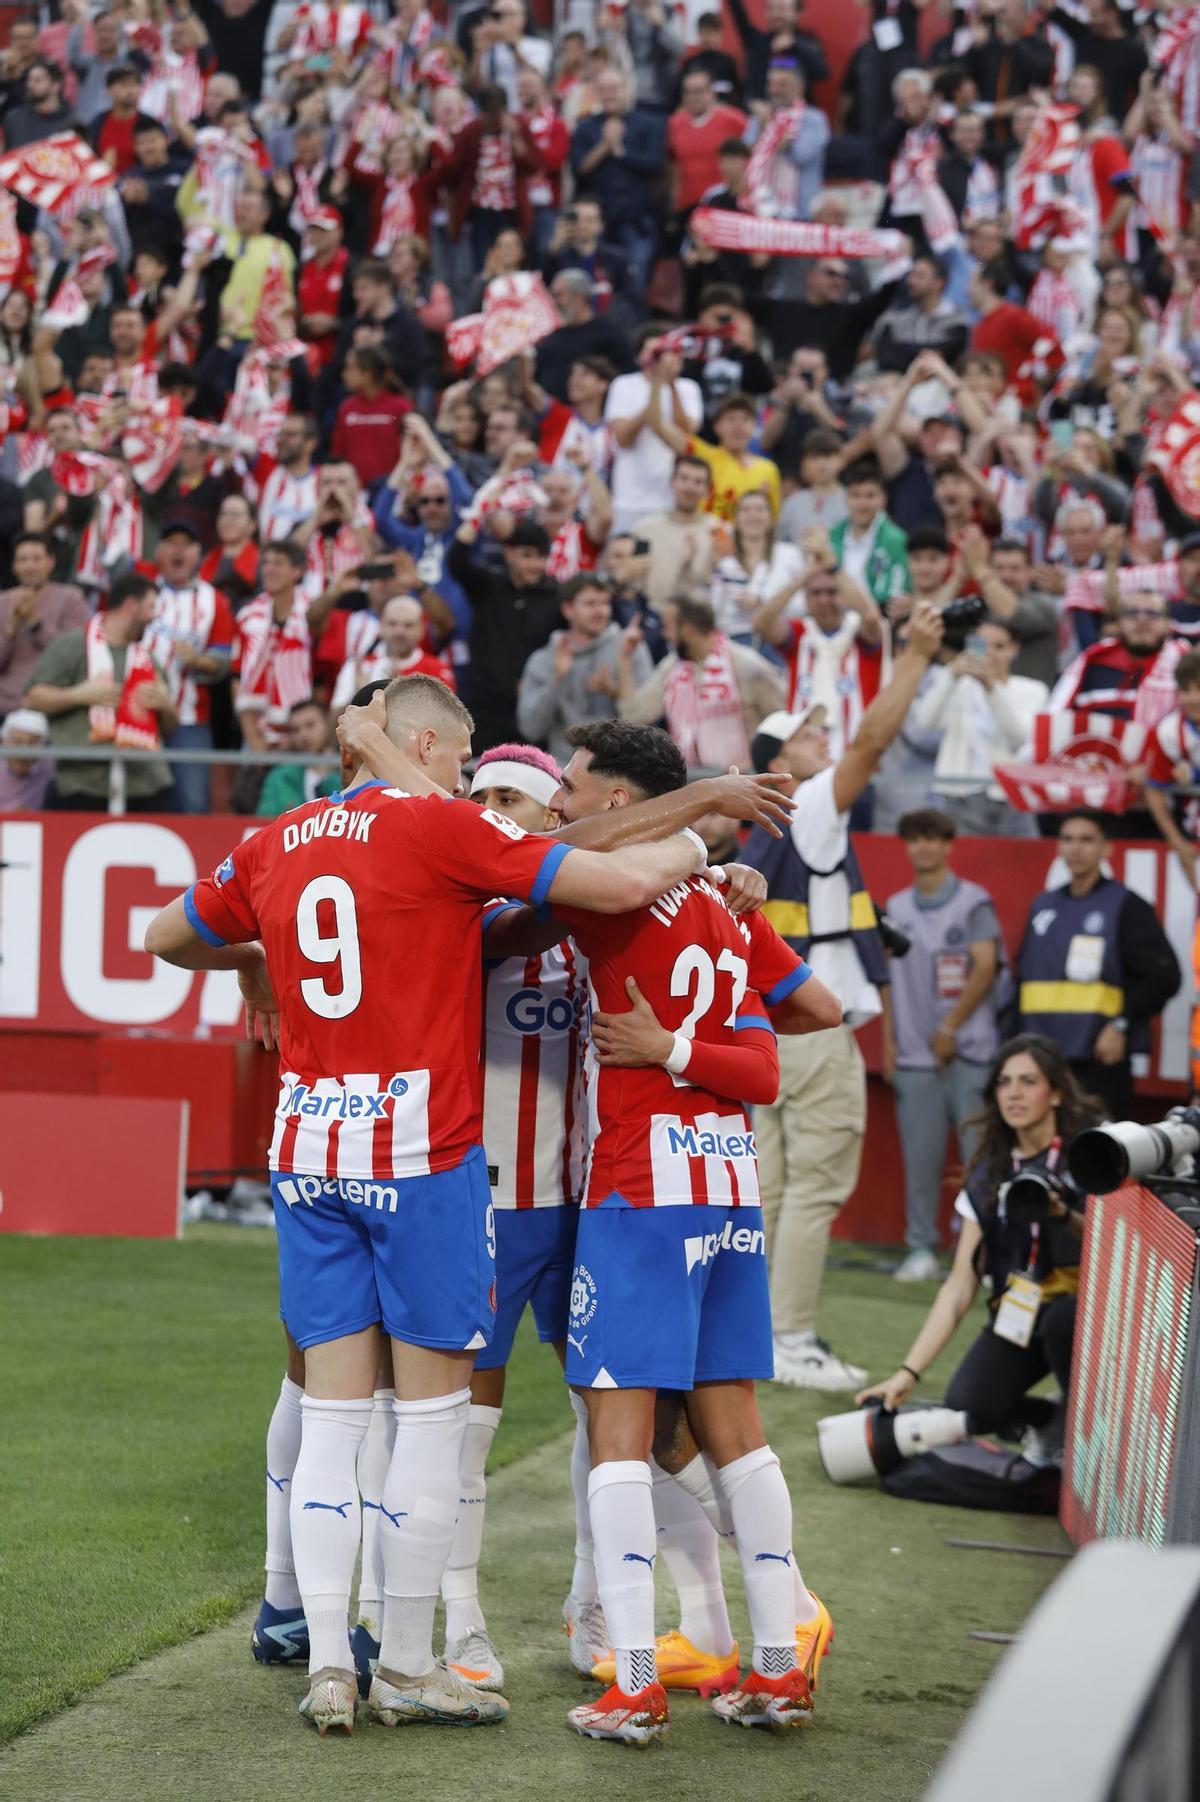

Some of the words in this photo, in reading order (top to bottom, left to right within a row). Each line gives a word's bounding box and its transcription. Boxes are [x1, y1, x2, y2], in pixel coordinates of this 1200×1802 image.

[283, 809, 377, 853] DOVBYK
[296, 874, 363, 1019] 9
[579, 1264, 597, 1294] Brava
[581, 1298, 598, 1326] Girona
